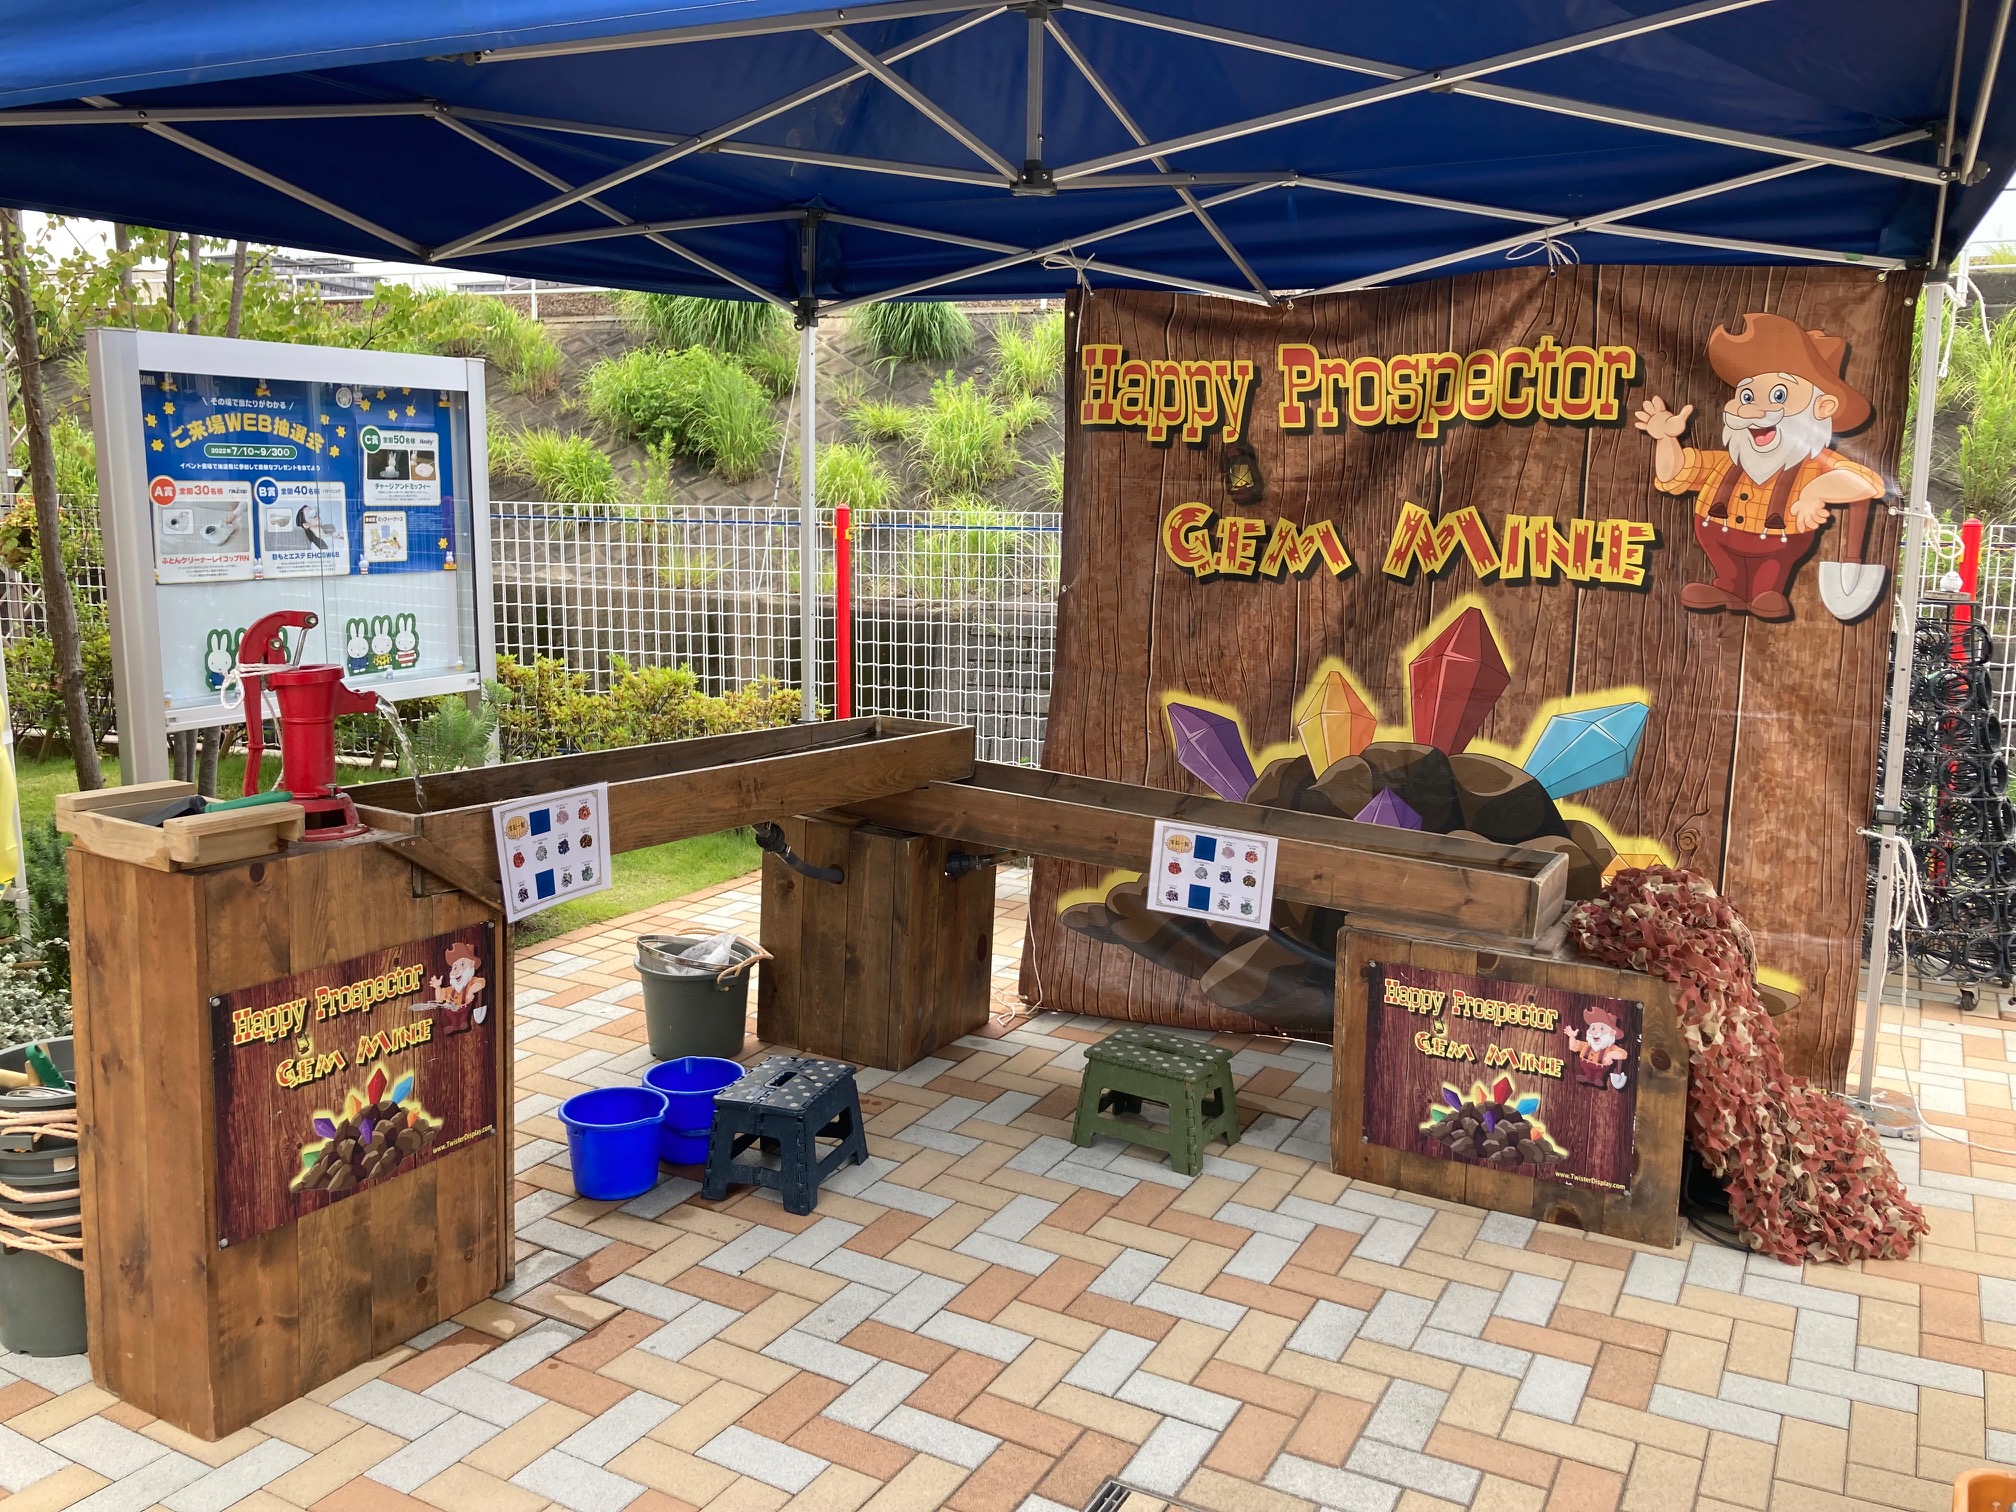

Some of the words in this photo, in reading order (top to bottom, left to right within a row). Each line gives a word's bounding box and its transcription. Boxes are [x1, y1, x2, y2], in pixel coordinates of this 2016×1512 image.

[210, 397, 286, 409] その場で当たりがわかる
[1081, 344, 1253, 442] Happy
[1279, 336, 1636, 439] Prospector
[171, 412, 325, 454] ご来場WEB抽選会
[154, 485, 173, 497] A賞
[258, 486, 276, 497] B賞
[1163, 502, 1353, 579] GEM
[1382, 501, 1655, 586] MINE
[233, 998, 307, 1045] Happy
[315, 964, 424, 1020] Prospector
[1384, 978, 1445, 1015] Happy
[1452, 989, 1558, 1030] Prospector
[276, 1049, 346, 1088] GEM
[355, 1018, 432, 1064] MINE
[1414, 1031, 1475, 1061] GEM
[1484, 1043, 1565, 1078] MINE
[432, 1124, 493, 1154] www.TwisterDisplay.com
[1555, 1170, 1626, 1190] www.TwisterDisplay.com
